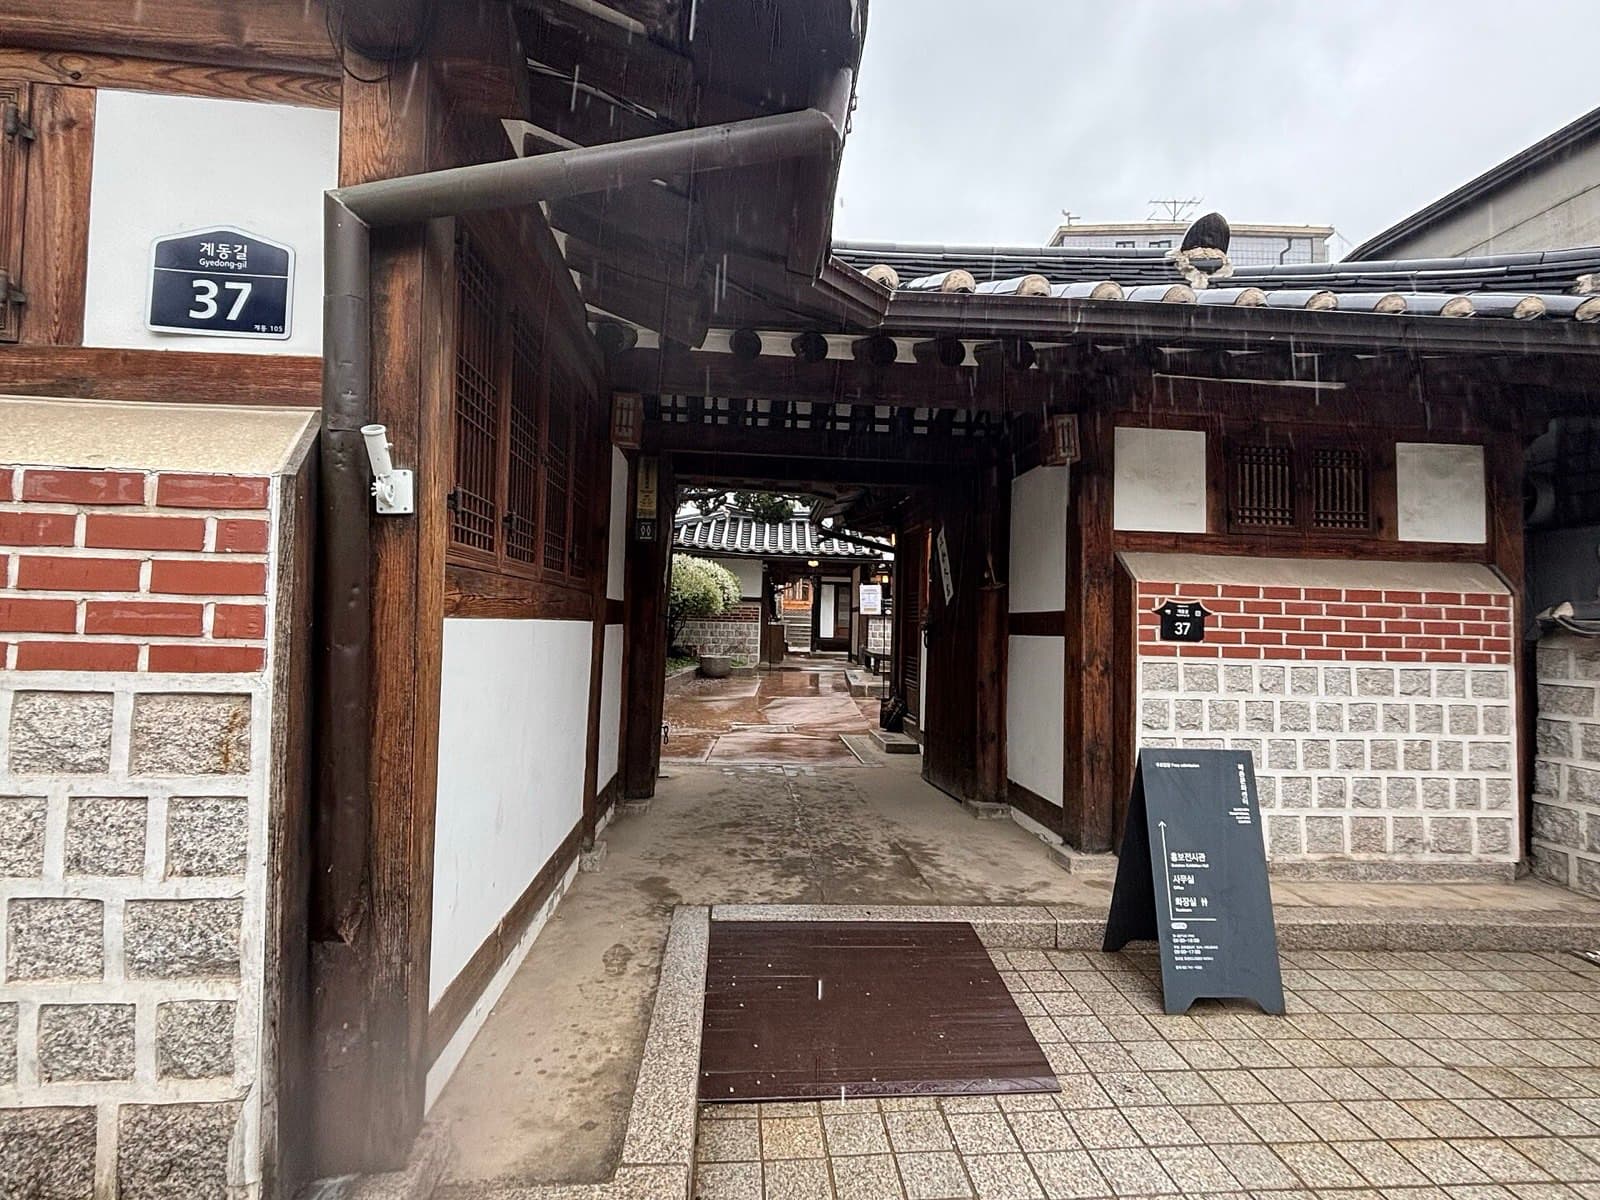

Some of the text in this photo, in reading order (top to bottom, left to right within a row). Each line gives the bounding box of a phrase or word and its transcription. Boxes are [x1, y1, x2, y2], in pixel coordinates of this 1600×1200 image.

[199, 242, 248, 260] 계동길
[199, 258, 248, 269] Gyedong-gil
[189, 279, 252, 321] 37
[254, 324, 283, 333] 계동 105
[1174, 621, 1191, 635] 37
[1170, 852, 1206, 862] 홍보전시관
[1173, 874, 1195, 884] 사무실
[1175, 897, 1197, 907] 화장실
